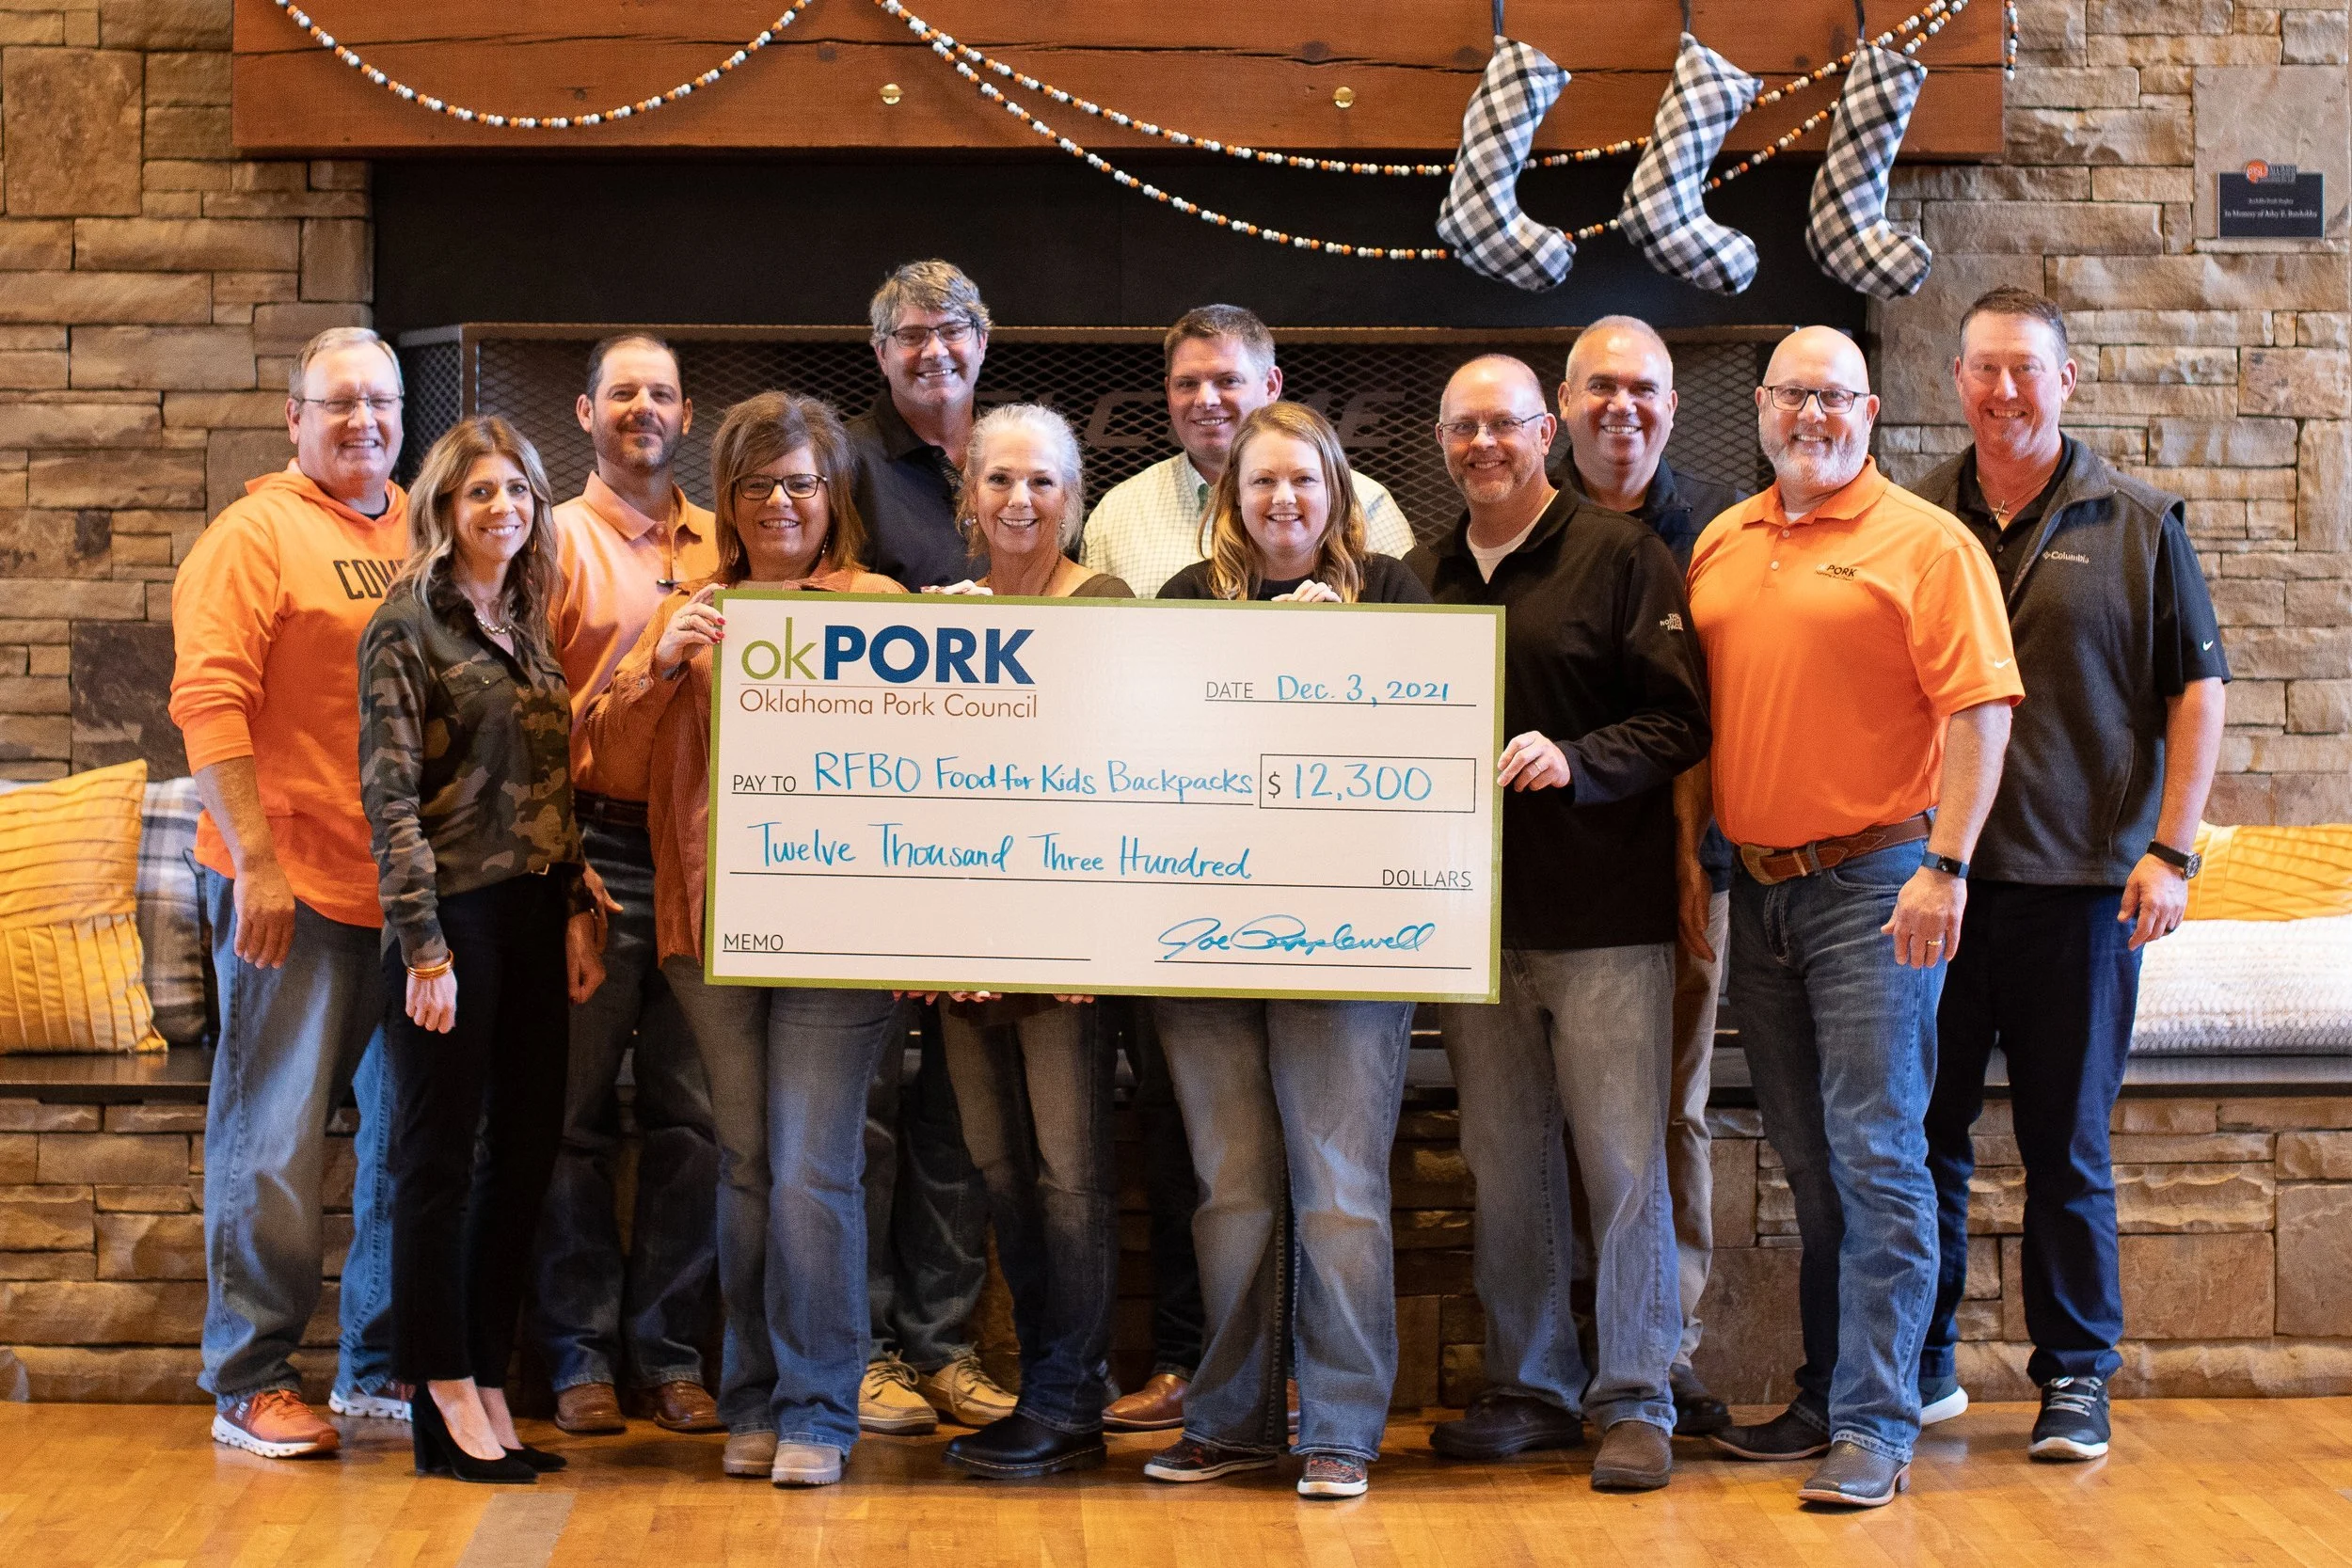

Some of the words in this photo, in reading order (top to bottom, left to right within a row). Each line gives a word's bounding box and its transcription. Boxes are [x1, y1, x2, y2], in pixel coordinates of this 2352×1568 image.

[2051, 550, 2090, 564] Columbia
[1206, 681, 1254, 699] DATE
[1277, 674, 1335, 701] Dec.
[1346, 673, 1378, 707] 3,
[1386, 680, 1449, 702] 2021
[739, 688, 873, 714] Oklahoma
[883, 691, 935, 716] Pork
[944, 692, 1037, 718] Council
[733, 774, 767, 792] PAY
[771, 775, 797, 793] TO
[815, 752, 921, 793] RFBO
[936, 755, 995, 789] Food
[1000, 764, 1035, 791] for
[1041, 764, 1097, 795] Kids
[1107, 760, 1253, 804] Backpacks
[747, 821, 856, 866] Twelve
[867, 823, 1014, 872] Thousand
[1027, 832, 1104, 871] Three
[1120, 835, 1252, 879] Hundred
[1382, 869, 1472, 888] DOLLARS
[723, 933, 784, 951] MEMO
